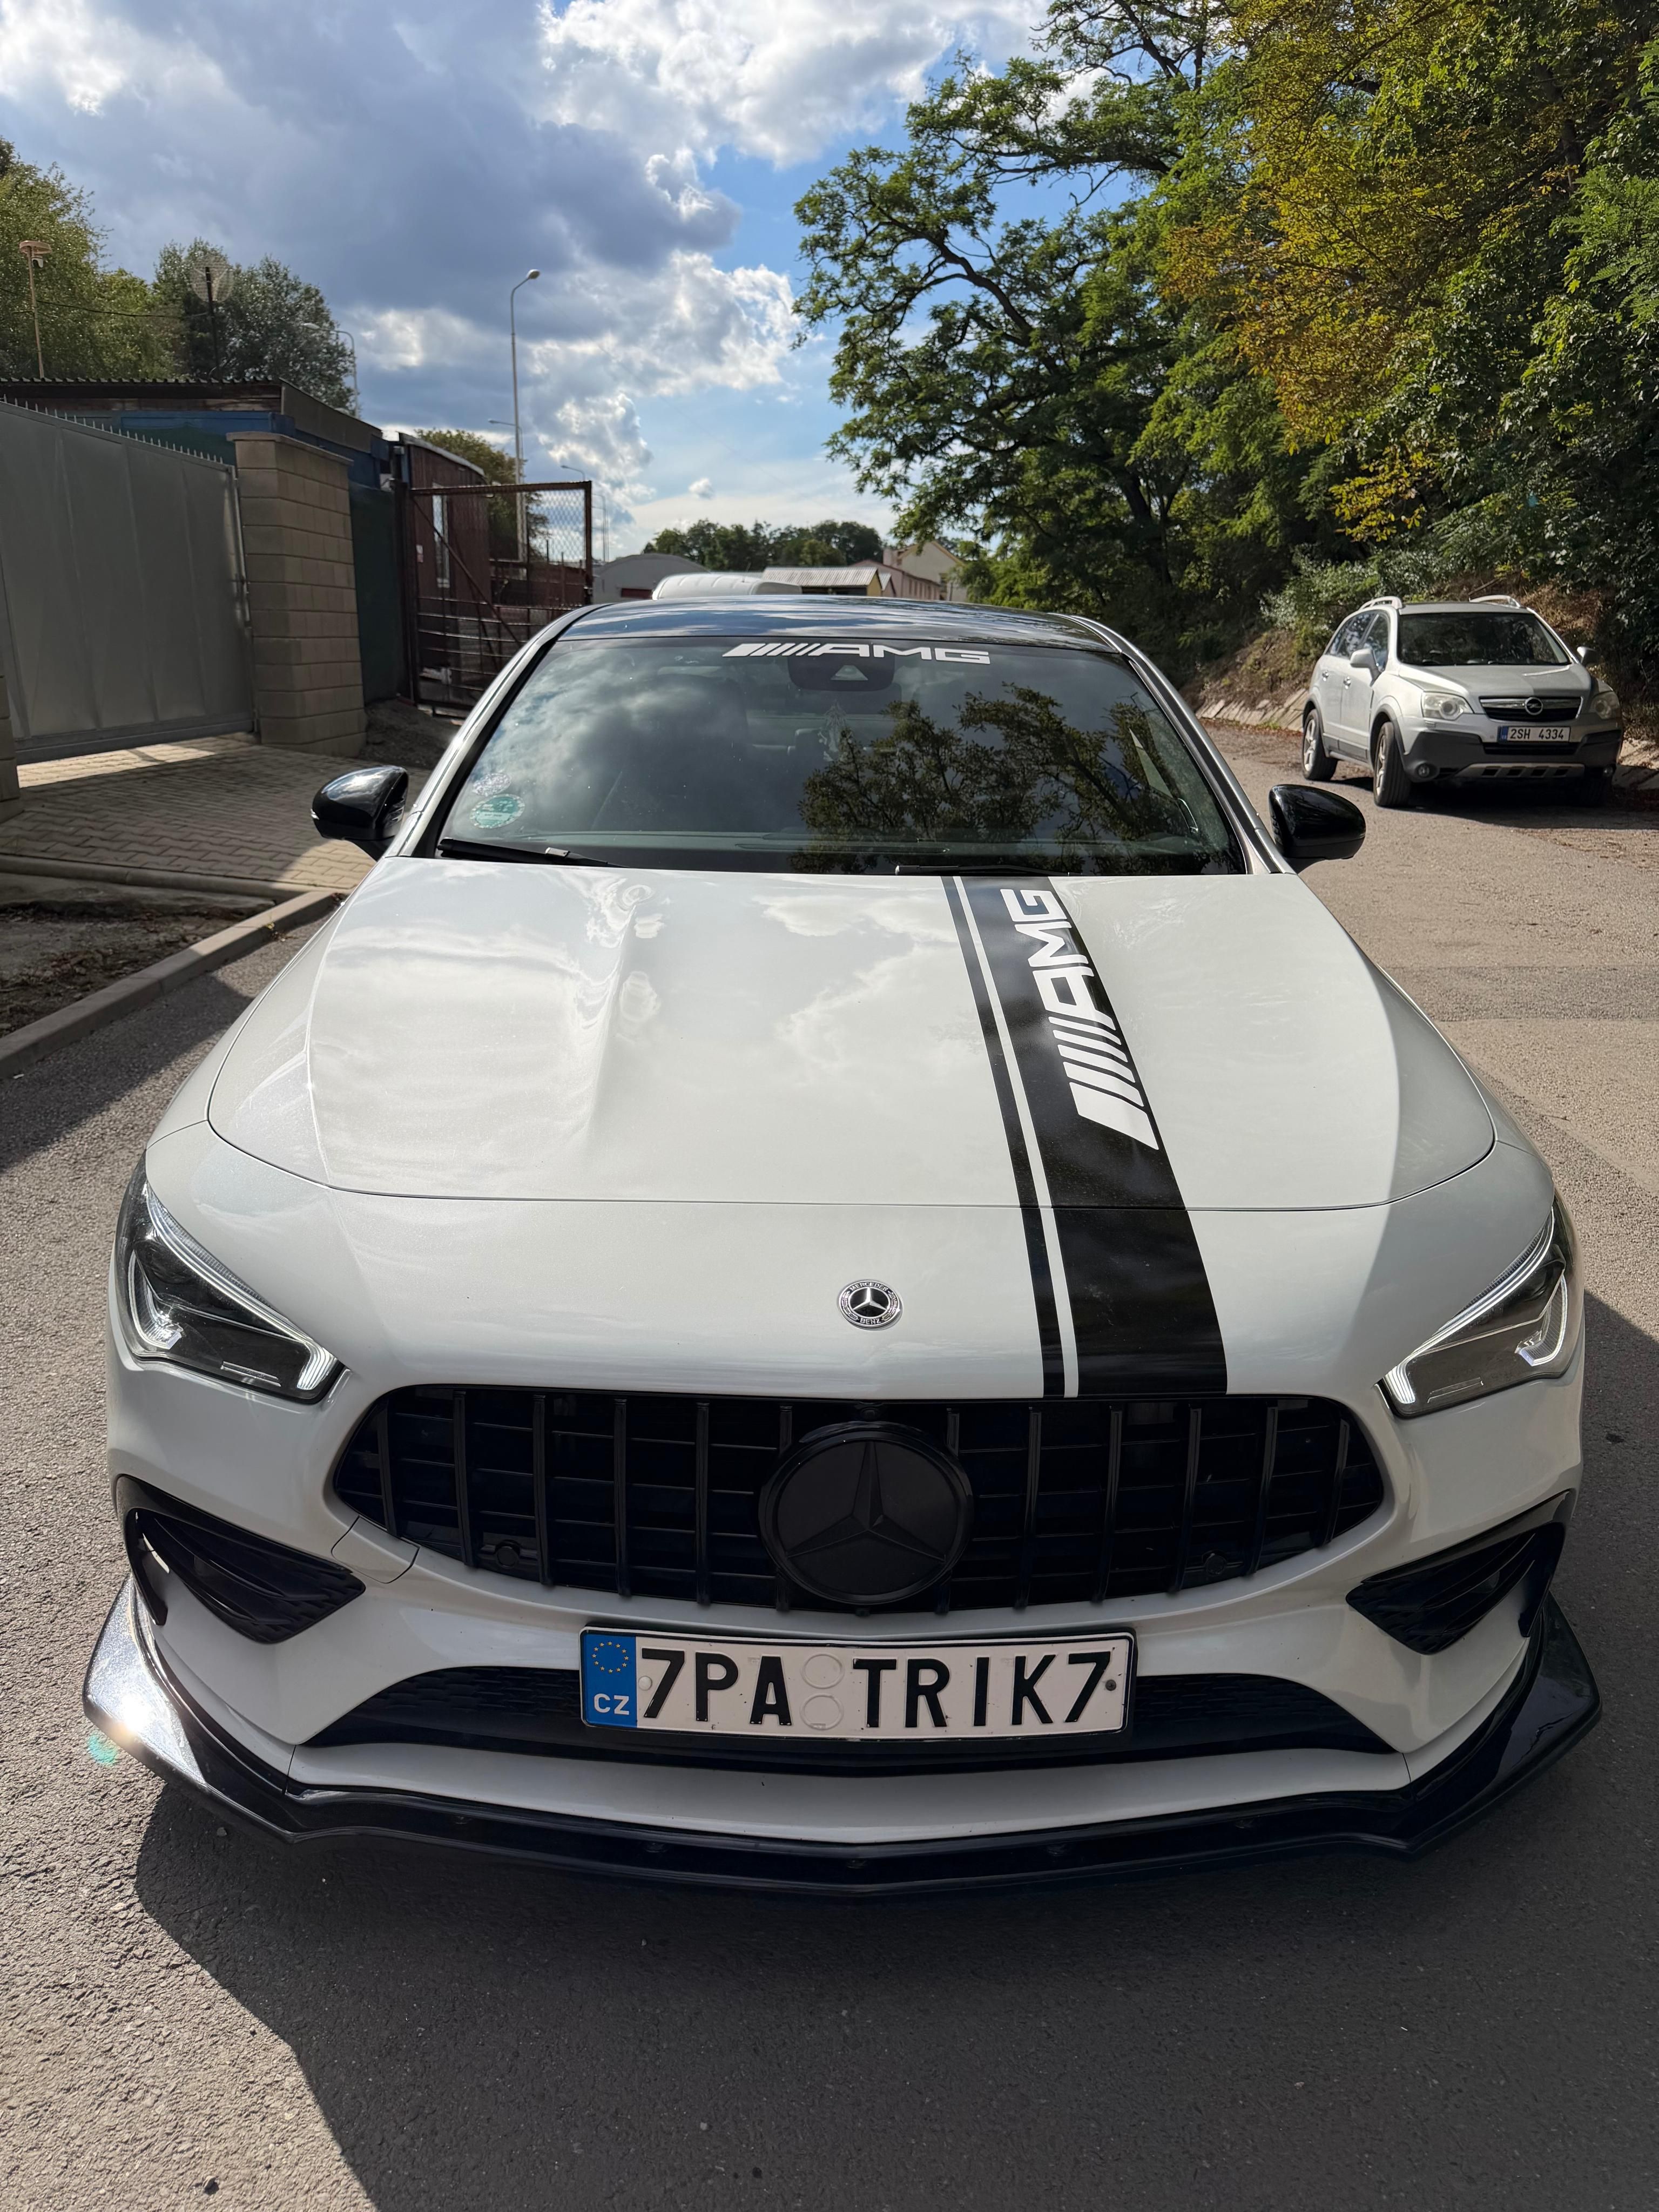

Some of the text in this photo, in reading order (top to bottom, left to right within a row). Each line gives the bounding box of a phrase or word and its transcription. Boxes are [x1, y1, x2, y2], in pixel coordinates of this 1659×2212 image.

[808, 643, 990, 664] AMG
[1509, 728, 1531, 740] 2SH
[1538, 728, 1564, 740] 4334
[1000, 889, 1116, 1030] AMG
[849, 1282, 889, 1291] MERCEDES
[594, 1693, 630, 1716] CZ
